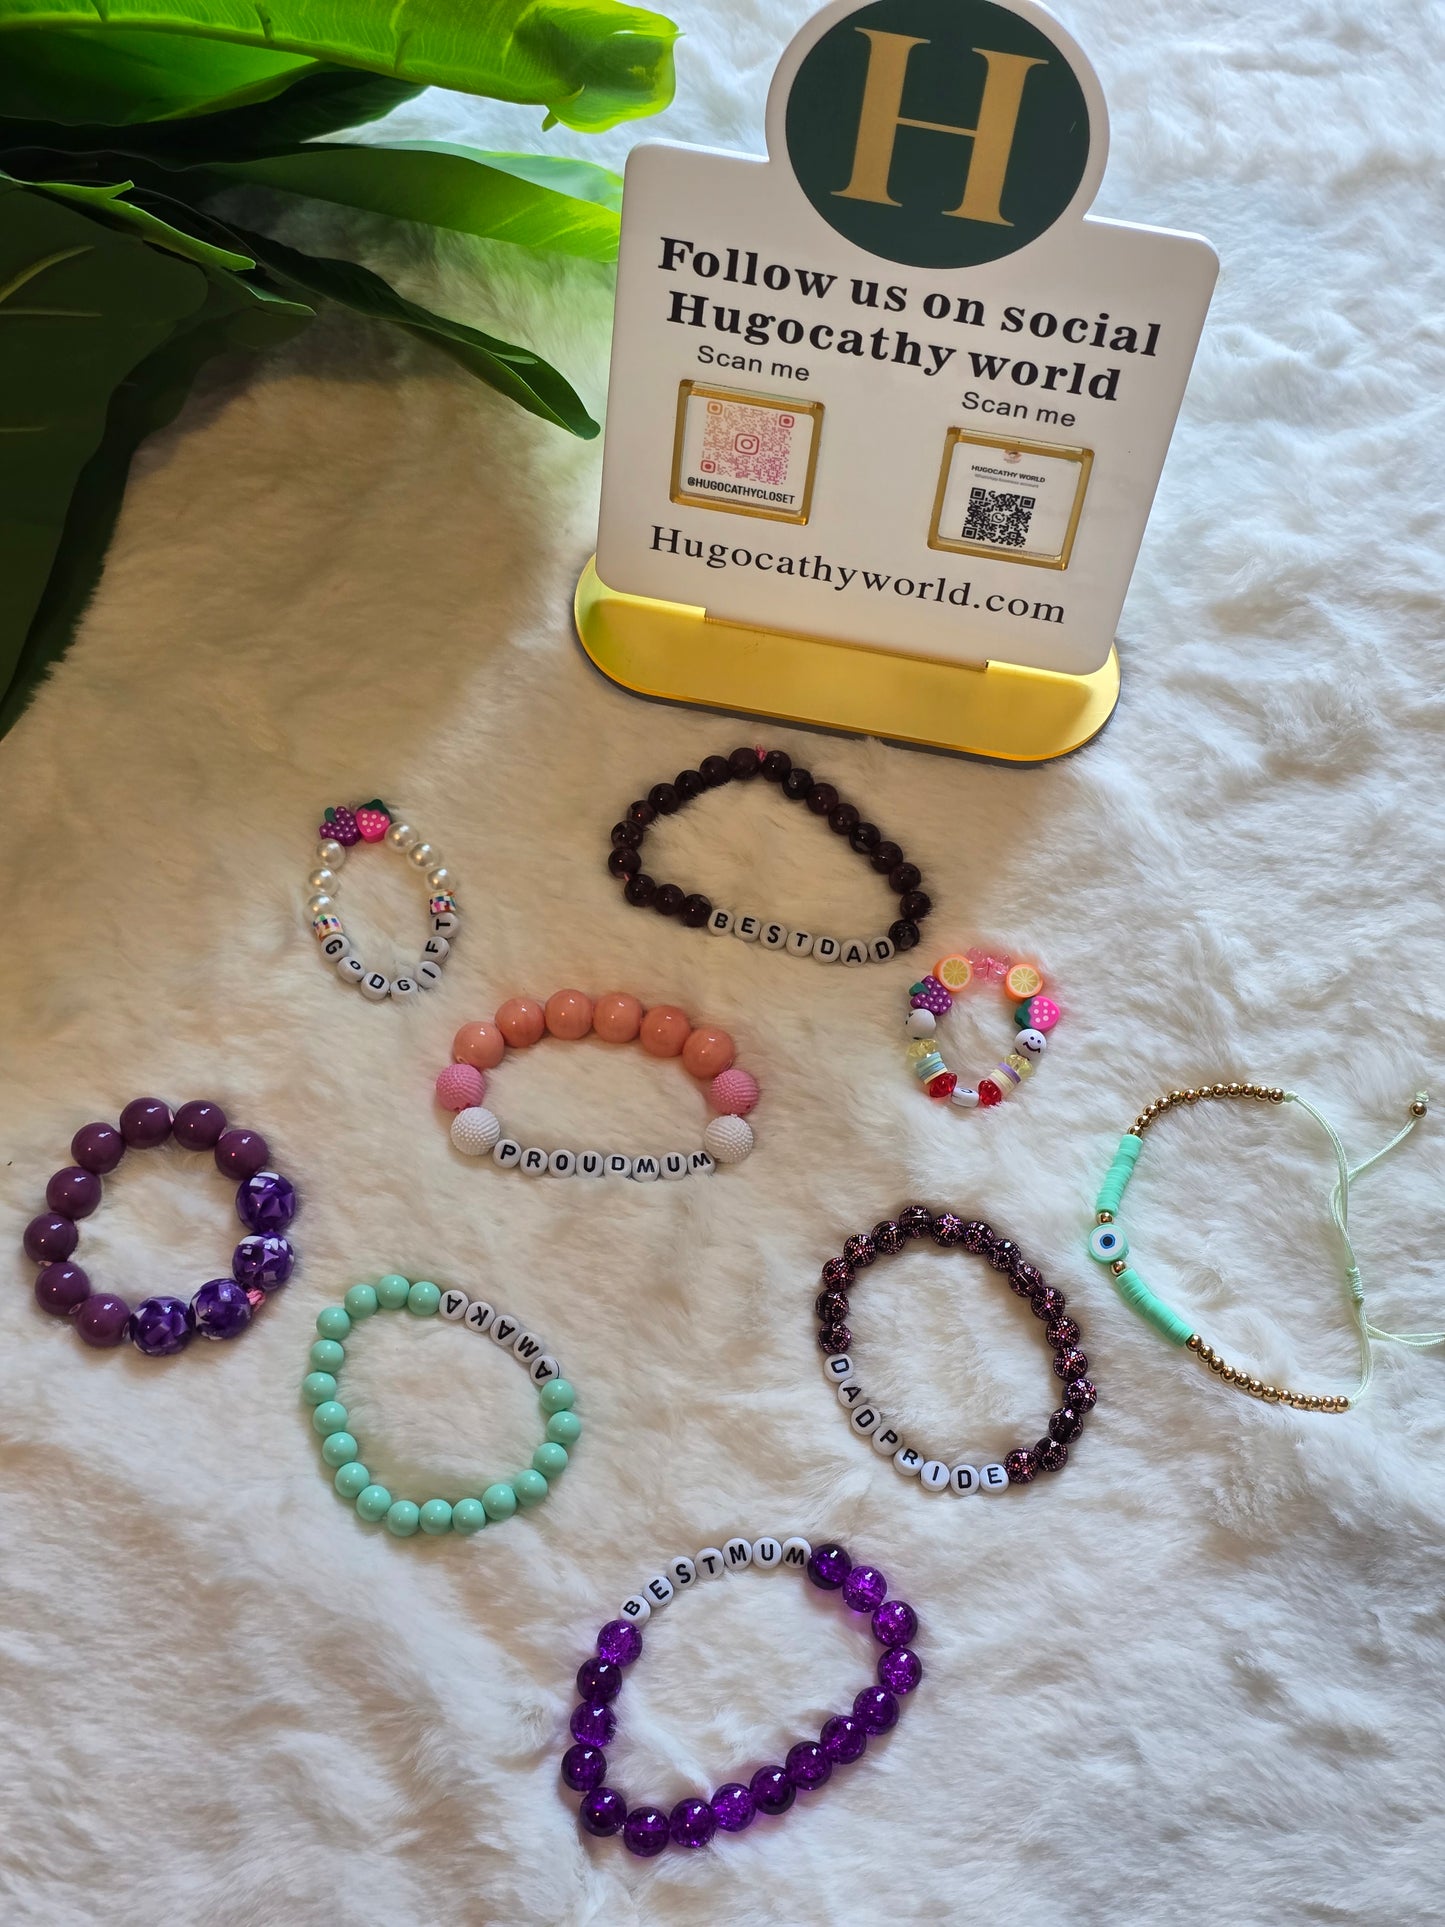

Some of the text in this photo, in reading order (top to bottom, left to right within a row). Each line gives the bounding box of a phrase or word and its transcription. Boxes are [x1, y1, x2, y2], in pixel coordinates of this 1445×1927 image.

[830, 27, 1050, 227] H
[657, 236, 1163, 357] Follow us on social
[666, 291, 1122, 401] Hugocathy world
[697, 344, 811, 382] Scan me
[961, 391, 1077, 428] Scan me
[687, 476, 796, 504] @HUGOCATHYCLOSET
[971, 464, 1018, 478] HUGOCATHY
[1018, 472, 1046, 483] WORLD
[649, 524, 1066, 625] Hugocathyworld.com
[714, 912, 890, 963] BESTDAD
[499, 1144, 712, 1173] PROUDMUM
[447, 1294, 553, 1380] AMAKA
[623, 1543, 805, 1616] BESTMUM
